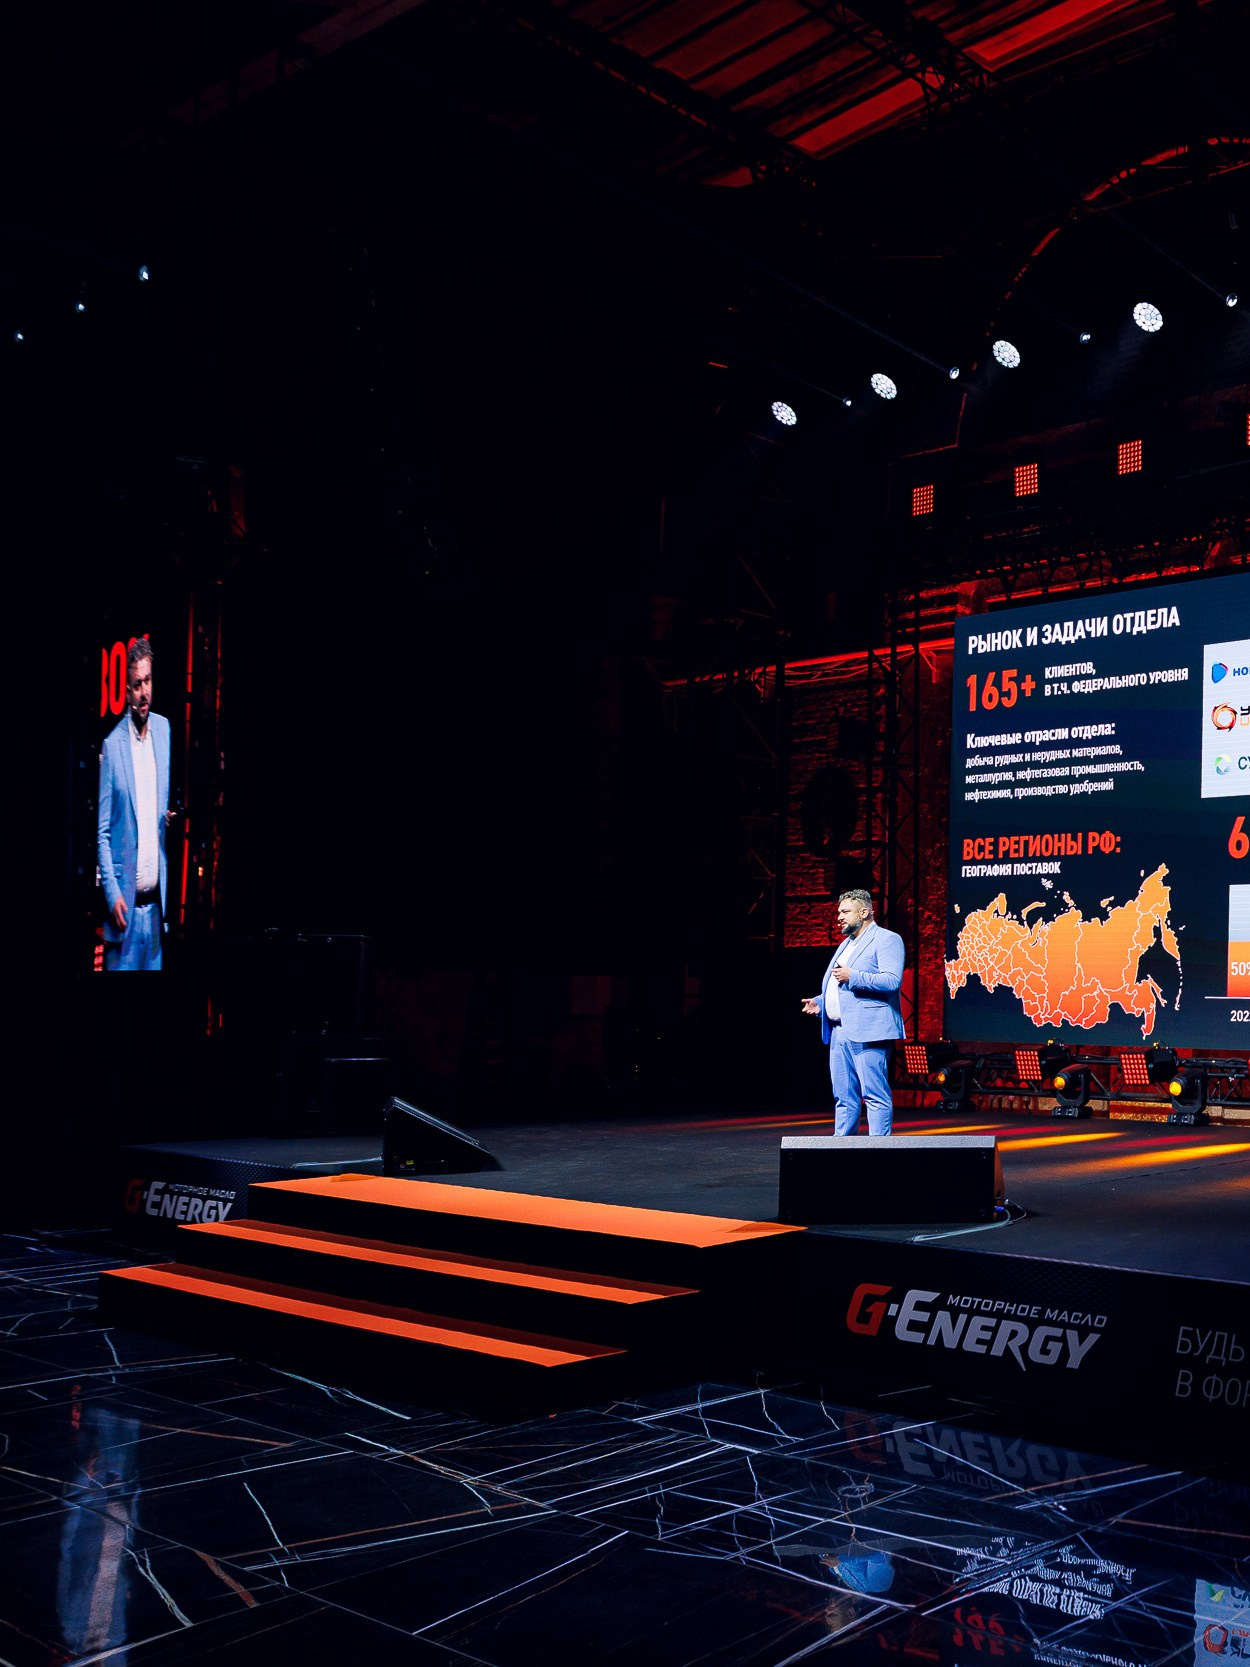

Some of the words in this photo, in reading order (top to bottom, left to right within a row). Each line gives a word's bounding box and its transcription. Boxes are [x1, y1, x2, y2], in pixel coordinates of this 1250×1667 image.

[968, 627, 1022, 654] РЫНОК
[1027, 626, 1037, 646] И
[1042, 617, 1108, 645] ЗАДАЧИ
[1113, 606, 1180, 634] ОТДЕЛА
[1045, 662, 1096, 679] КЛИЕНТОВ,
[1045, 684, 1051, 696] В
[1053, 682, 1070, 695] Т.Ч.
[1072, 673, 1147, 693] ФЕДЕРАЛЬНОГО
[1149, 668, 1188, 684] УРОВНЯ
[966, 669, 1036, 711] 165+
[967, 732, 1021, 748] Ключевые
[1024, 727, 1068, 745] отрасли
[1071, 723, 1115, 740] отдела:
[966, 754, 993, 768] добыча
[995, 751, 1023, 767] рудных
[1025, 753, 1030, 761] и
[1032, 749, 1070, 763] нерудных
[1072, 744, 1122, 757] материалов,
[966, 771, 1014, 784] металлургия,
[1017, 766, 1069, 781] нефтегазовая
[1071, 761, 1145, 777] промышленность,
[965, 787, 1013, 802] нефтехимия,
[1014, 784, 1068, 799] производство
[1070, 779, 1113, 796] удобрений
[963, 838, 994, 860] ВСЕ
[999, 833, 1082, 858] РЕГИОНЫ
[1088, 831, 1121, 854] РФ:
[962, 863, 1011, 877] ГЕОГРАФИЯ
[1014, 862, 1061, 874] ПОСТАВОК
[169, 1183, 208, 1196] МОТОРНОЕ
[210, 1188, 236, 1199] МАСЛО
[947, 1293, 1041, 1319] МОТОРНОЕ
[1044, 1309, 1107, 1328] МАСЛО
[1177, 1326, 1245, 1366] БУДЬ
[1175, 1369, 1192, 1397] В
